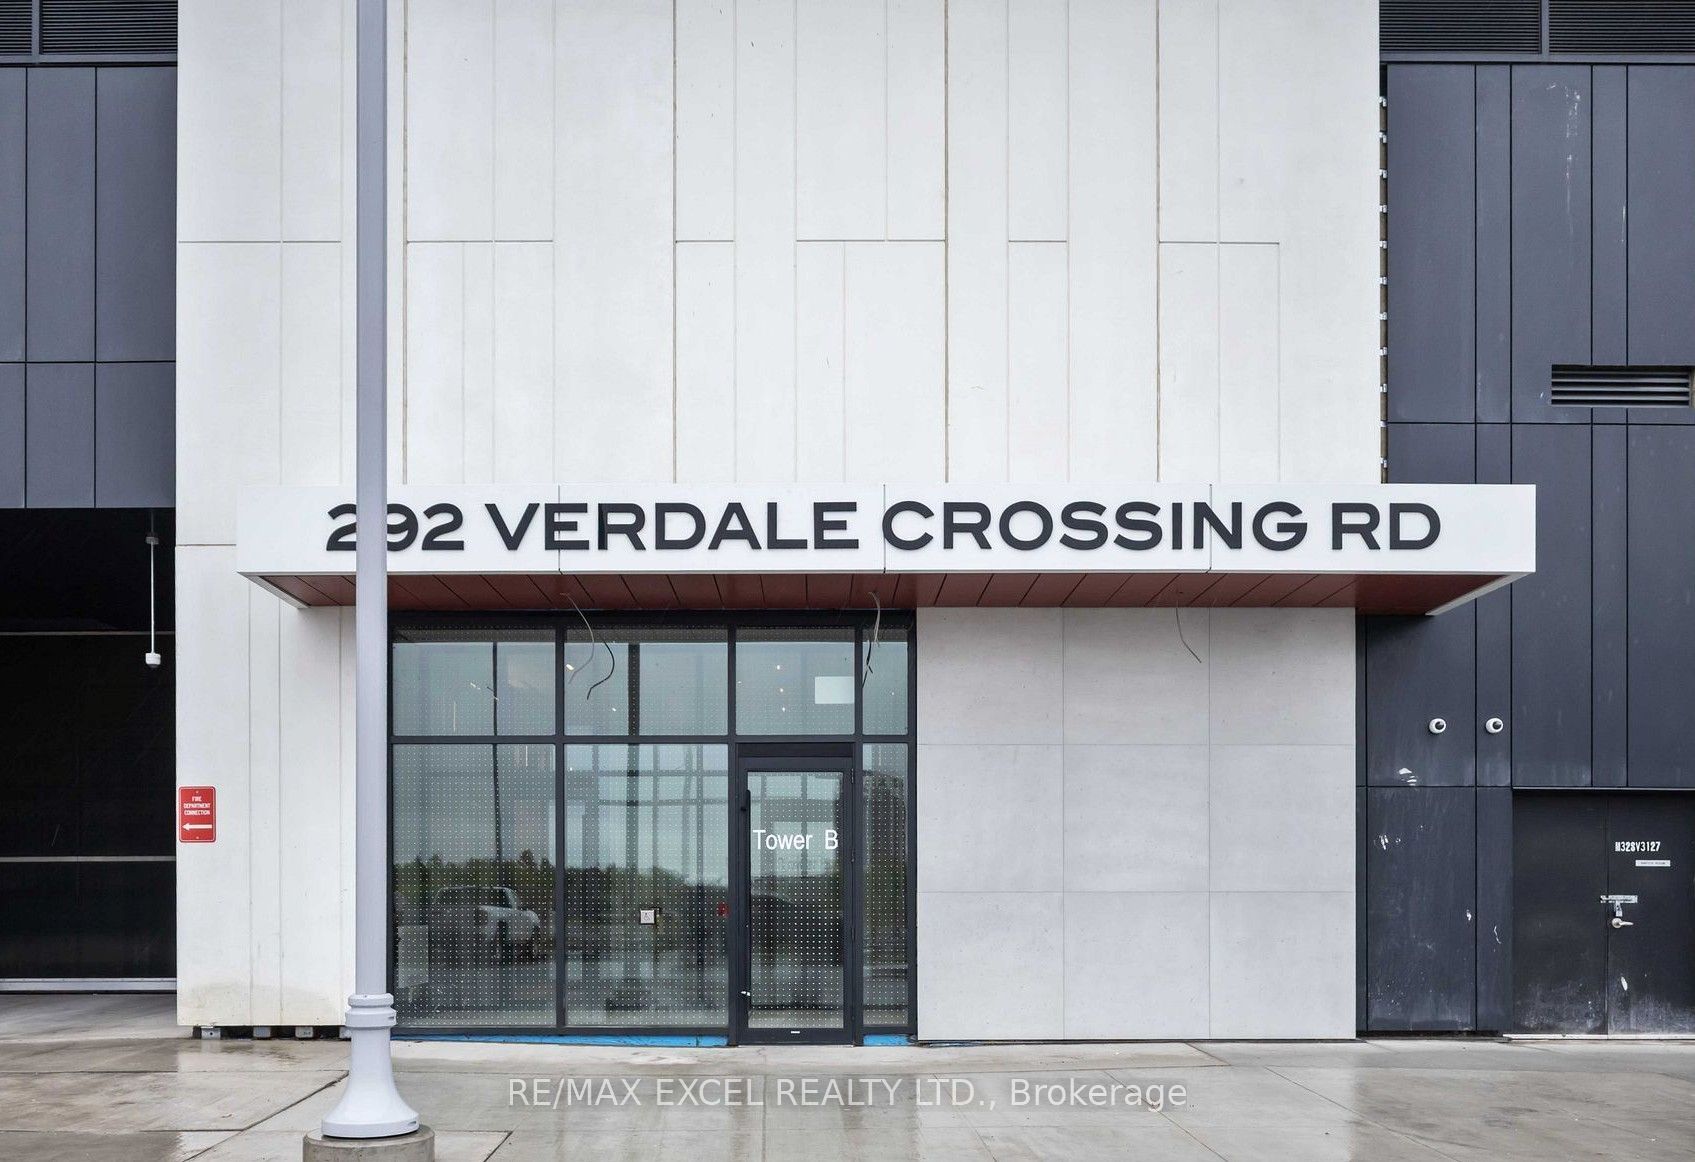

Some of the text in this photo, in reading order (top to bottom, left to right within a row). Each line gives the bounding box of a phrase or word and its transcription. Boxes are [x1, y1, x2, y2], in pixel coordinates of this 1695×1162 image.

[326, 500, 1441, 551] 292 VERDALE CROSSING RD
[752, 829, 839, 850] Tower B
